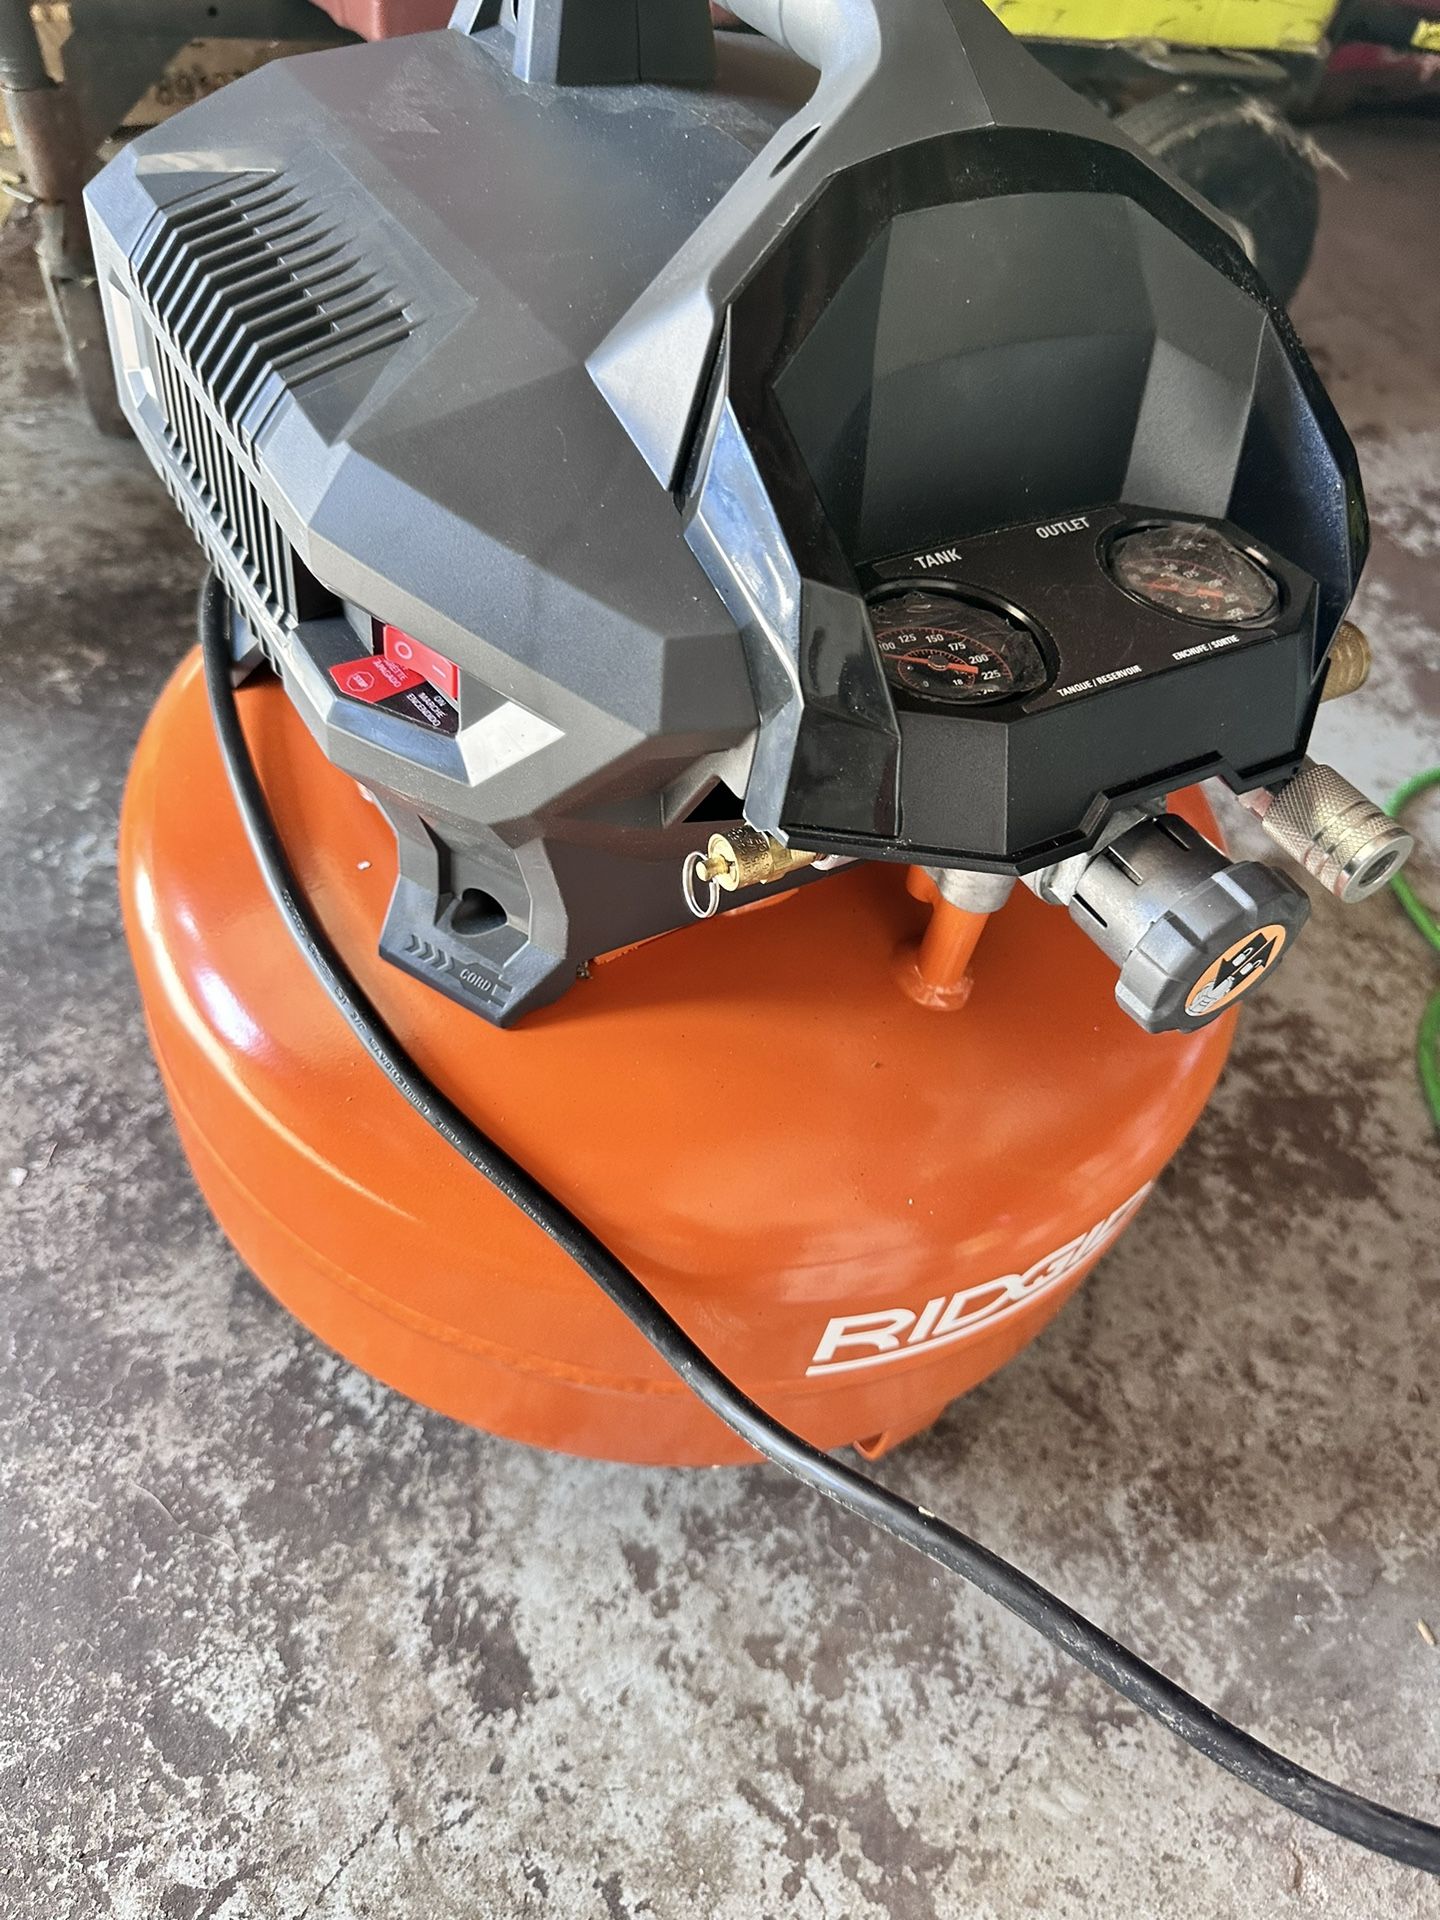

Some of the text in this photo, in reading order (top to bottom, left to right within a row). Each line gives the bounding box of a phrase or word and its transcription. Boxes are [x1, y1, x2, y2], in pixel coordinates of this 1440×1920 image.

[1035, 516, 1090, 539] OUTLET
[914, 548, 962, 569] TANK
[898, 633, 917, 644] 125
[925, 633, 944, 644] 150
[948, 641, 966, 652] 175
[1171, 643, 1209, 661] ENCHUFE
[1211, 634, 1240, 650] SORTIE
[968, 653, 989, 665] 200
[981, 669, 1001, 681] 225
[1057, 680, 1093, 698] TANQUE
[1096, 664, 1143, 686] RESERVOIR
[433, 695, 447, 707] ON
[459, 968, 492, 992] CORD
[811, 1180, 1152, 1363] RIDGI
